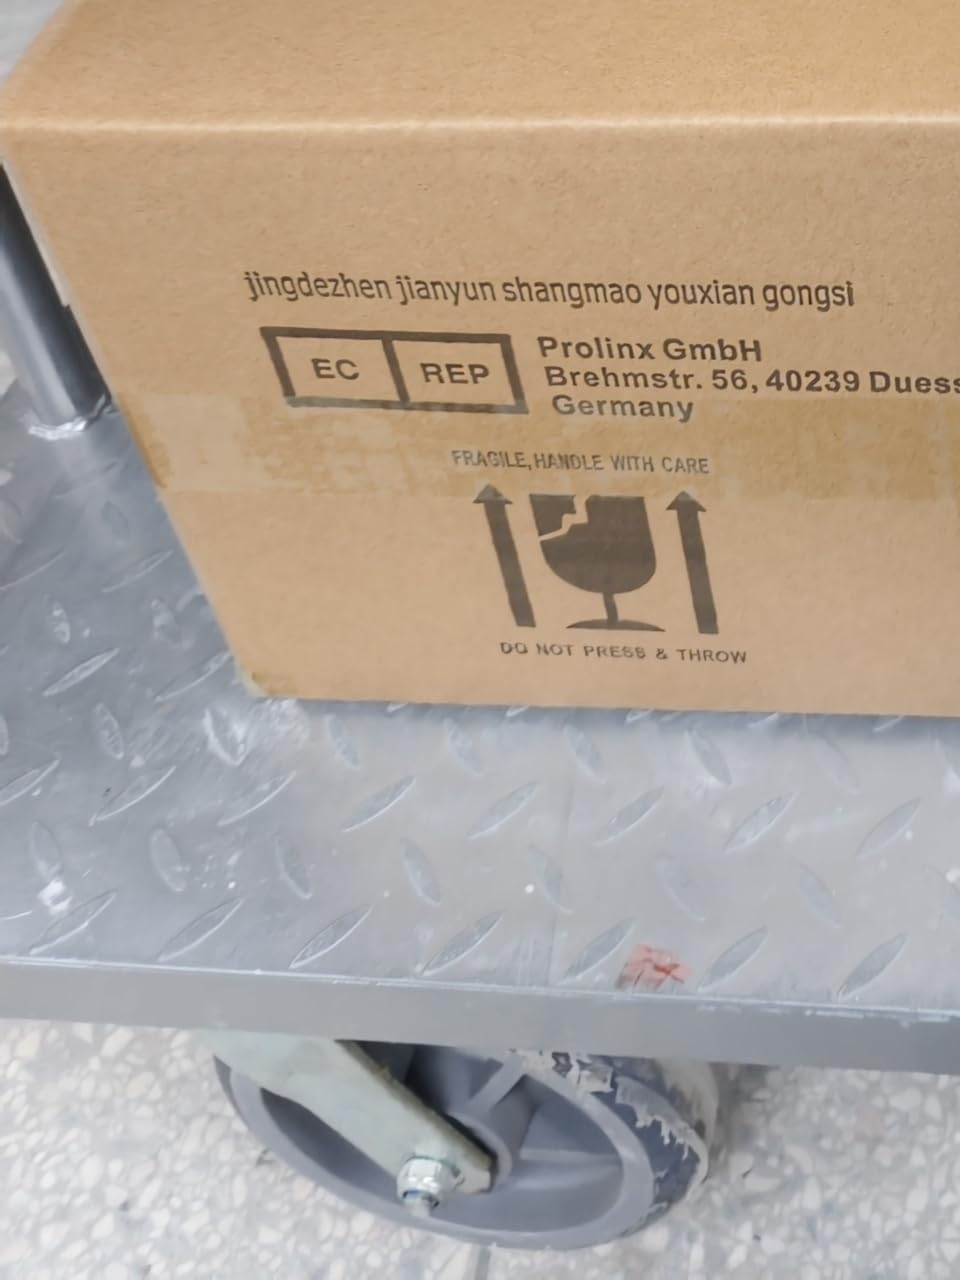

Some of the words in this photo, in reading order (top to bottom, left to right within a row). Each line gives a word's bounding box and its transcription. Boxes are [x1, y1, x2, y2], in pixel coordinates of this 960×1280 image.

[244, 271, 392, 301] jingdezhen
[396, 275, 497, 306] jianyun
[503, 276, 642, 309] shangmao
[647, 279, 755, 310] youxian
[762, 280, 854, 312] gongsi
[537, 336, 656, 360] Prolinx
[662, 338, 762, 362] GmbH
[311, 358, 359, 380] EC
[420, 362, 489, 384] REP
[544, 366, 702, 390] Brehmstr.
[552, 394, 694, 422] Germany
[610, 455, 655, 472] WITH
[661, 456, 709, 474] CARE
[500, 642, 528, 655] DO
[536, 643, 574, 657] NOT
[584, 645, 646, 659] PRESS
[656, 648, 668, 660] &
[676, 648, 747, 663] THROW
